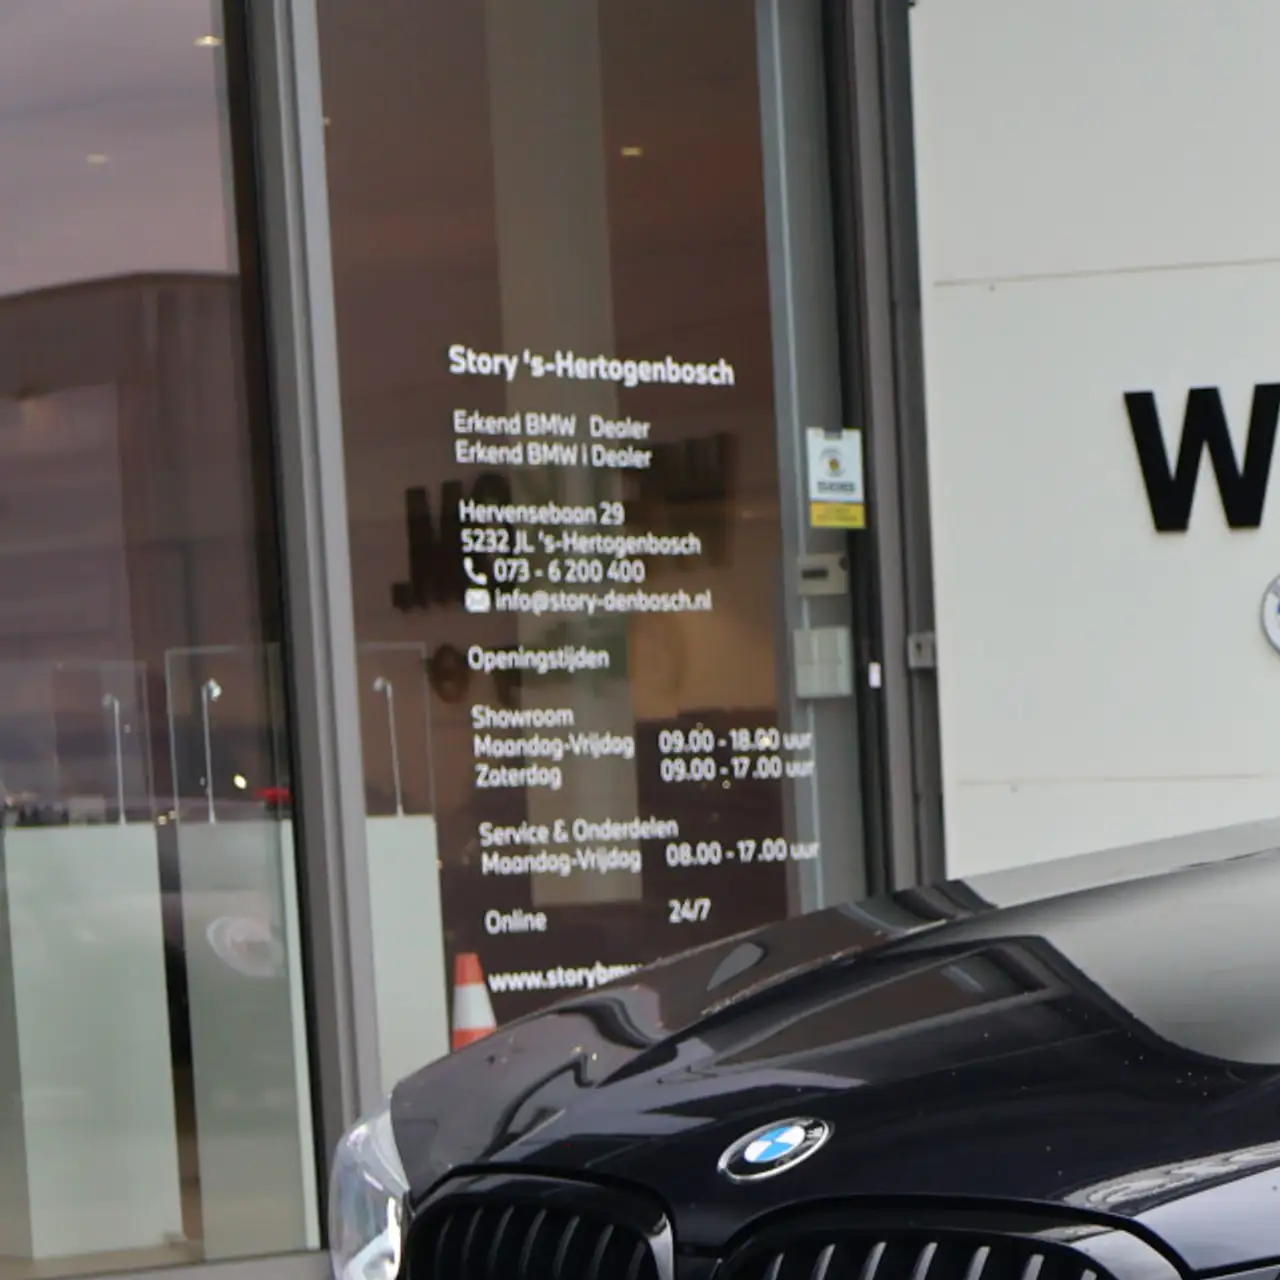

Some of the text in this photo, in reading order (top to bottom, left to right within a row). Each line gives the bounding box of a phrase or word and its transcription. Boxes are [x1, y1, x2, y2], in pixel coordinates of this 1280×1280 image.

[449, 344, 735, 387] Story 's-Hertogenbosch
[453, 409, 651, 440] Erkend BMW Dealer
[455, 438, 523, 464] Erkend
[527, 441, 578, 466] BMW
[591, 443, 653, 468] Dealer
[459, 499, 625, 526] Hervensebaan 29
[460, 528, 702, 559] 5232 JL 's-Hertogenbosch
[493, 557, 531, 583] 073
[547, 559, 561, 583] 6
[565, 558, 604, 584] 200
[607, 559, 646, 584] 400
[495, 588, 713, 616] info@story-denbosch.nl
[468, 646, 610, 672] Openingstijden
[471, 704, 575, 729] Showroom
[473, 731, 635, 761] Maandag-Vrijdag
[658, 729, 715, 753] 09.00
[729, 727, 780, 751] 18.00
[782, 732, 813, 751] uur
[475, 763, 563, 790] Zaterdag
[660, 757, 717, 781] 09.00
[785, 760, 816, 778] uur
[478, 815, 679, 847] Service & Onderdelen
[481, 845, 642, 877] Maandag-Vrijdag
[666, 841, 722, 867] 08.00
[790, 842, 820, 860] uur
[485, 898, 711, 935] Online 24/7
